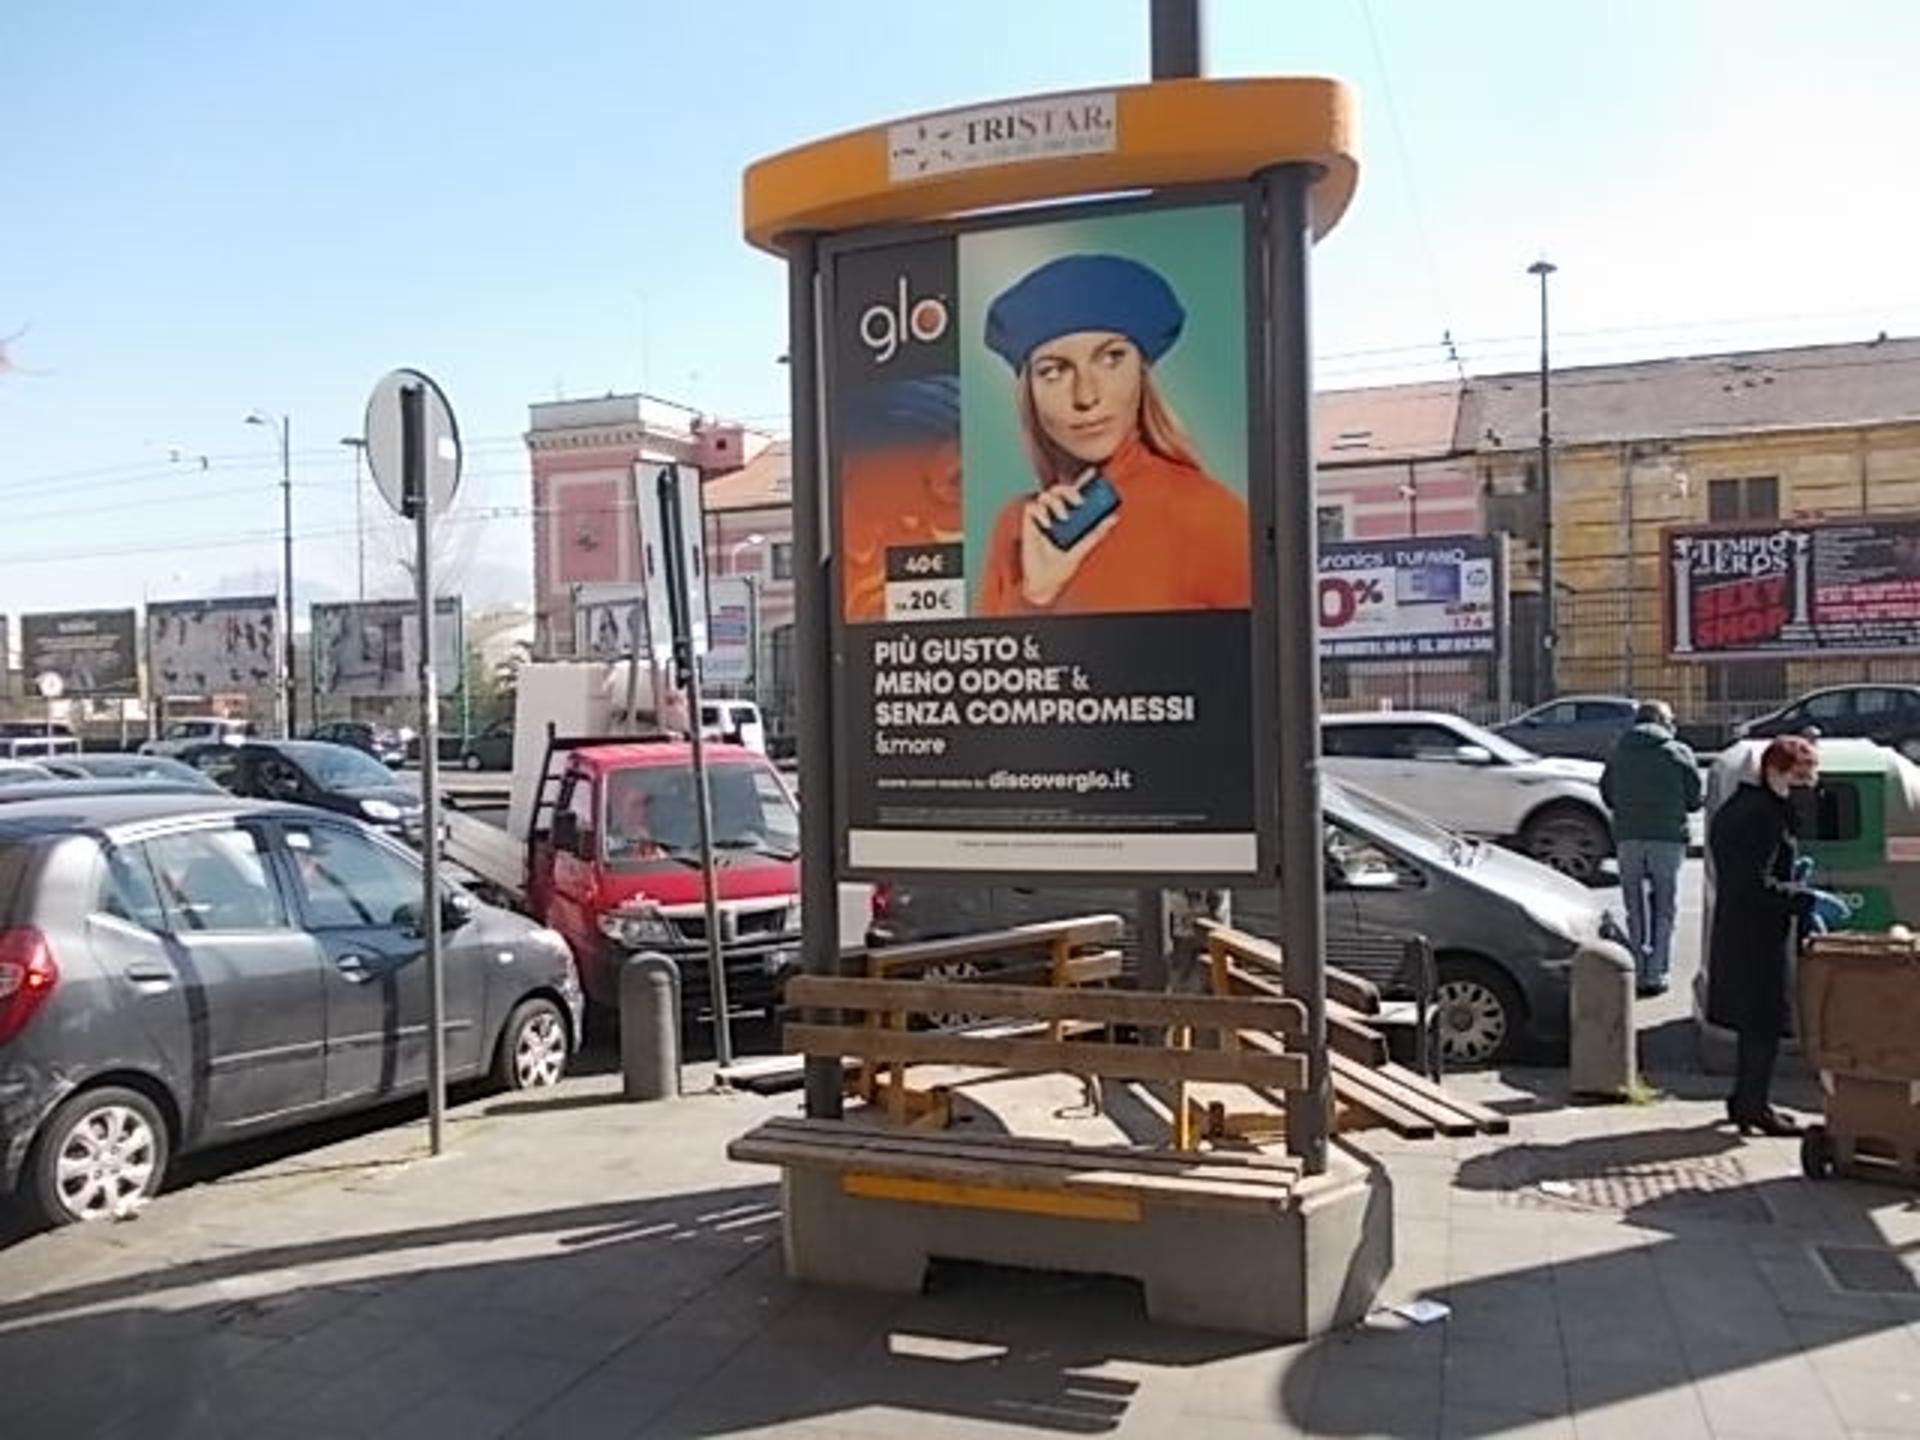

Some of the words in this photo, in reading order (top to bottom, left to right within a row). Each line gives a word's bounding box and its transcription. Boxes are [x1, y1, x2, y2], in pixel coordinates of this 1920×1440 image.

[861, 276, 947, 362] glo
[875, 634, 916, 665] PIÙ
[922, 636, 1018, 663] GUSTO
[875, 669, 954, 694] MENO
[959, 668, 1060, 693] ODORE
[875, 701, 960, 726] SENZA
[965, 696, 1195, 725] COMPROMESSI
